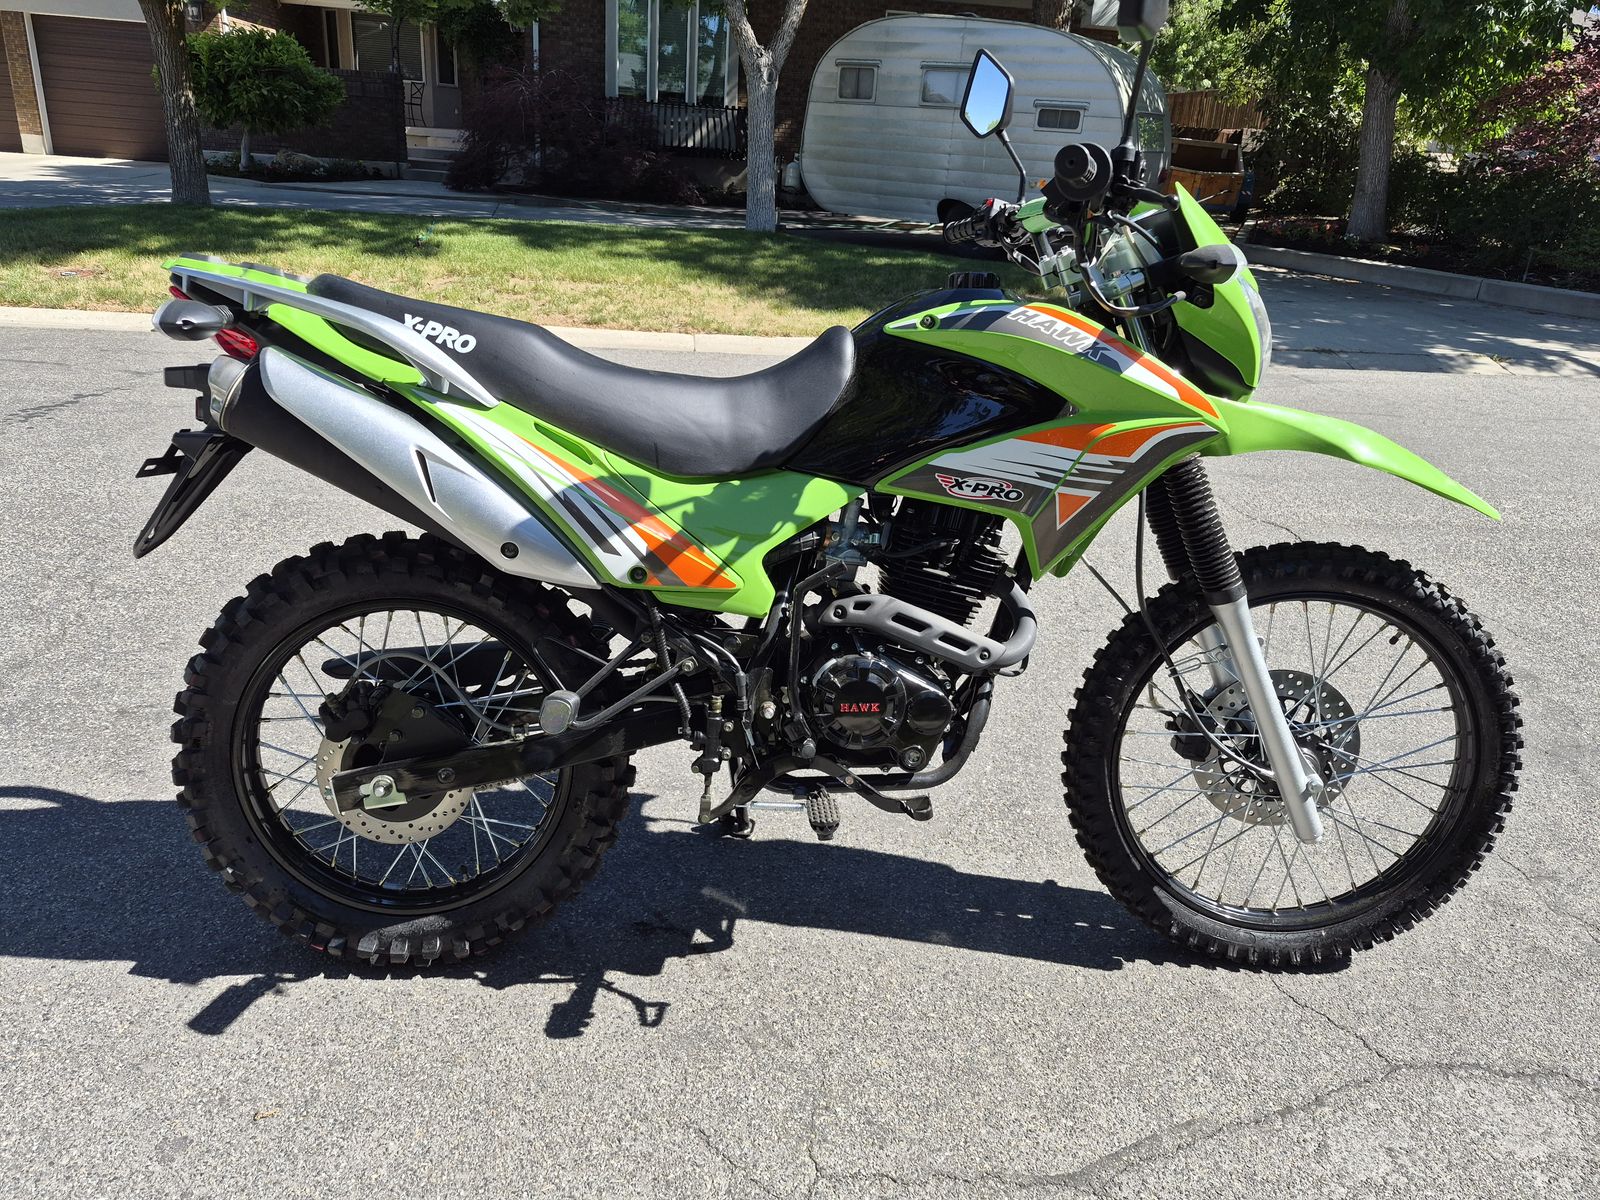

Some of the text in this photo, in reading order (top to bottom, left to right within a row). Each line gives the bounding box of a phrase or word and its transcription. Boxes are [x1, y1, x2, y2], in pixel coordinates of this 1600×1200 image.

[404, 313, 477, 354] X-PRO
[1006, 309, 1111, 361] HAWK
[949, 478, 1023, 501] X-PRO
[840, 703, 880, 712] HAWK
